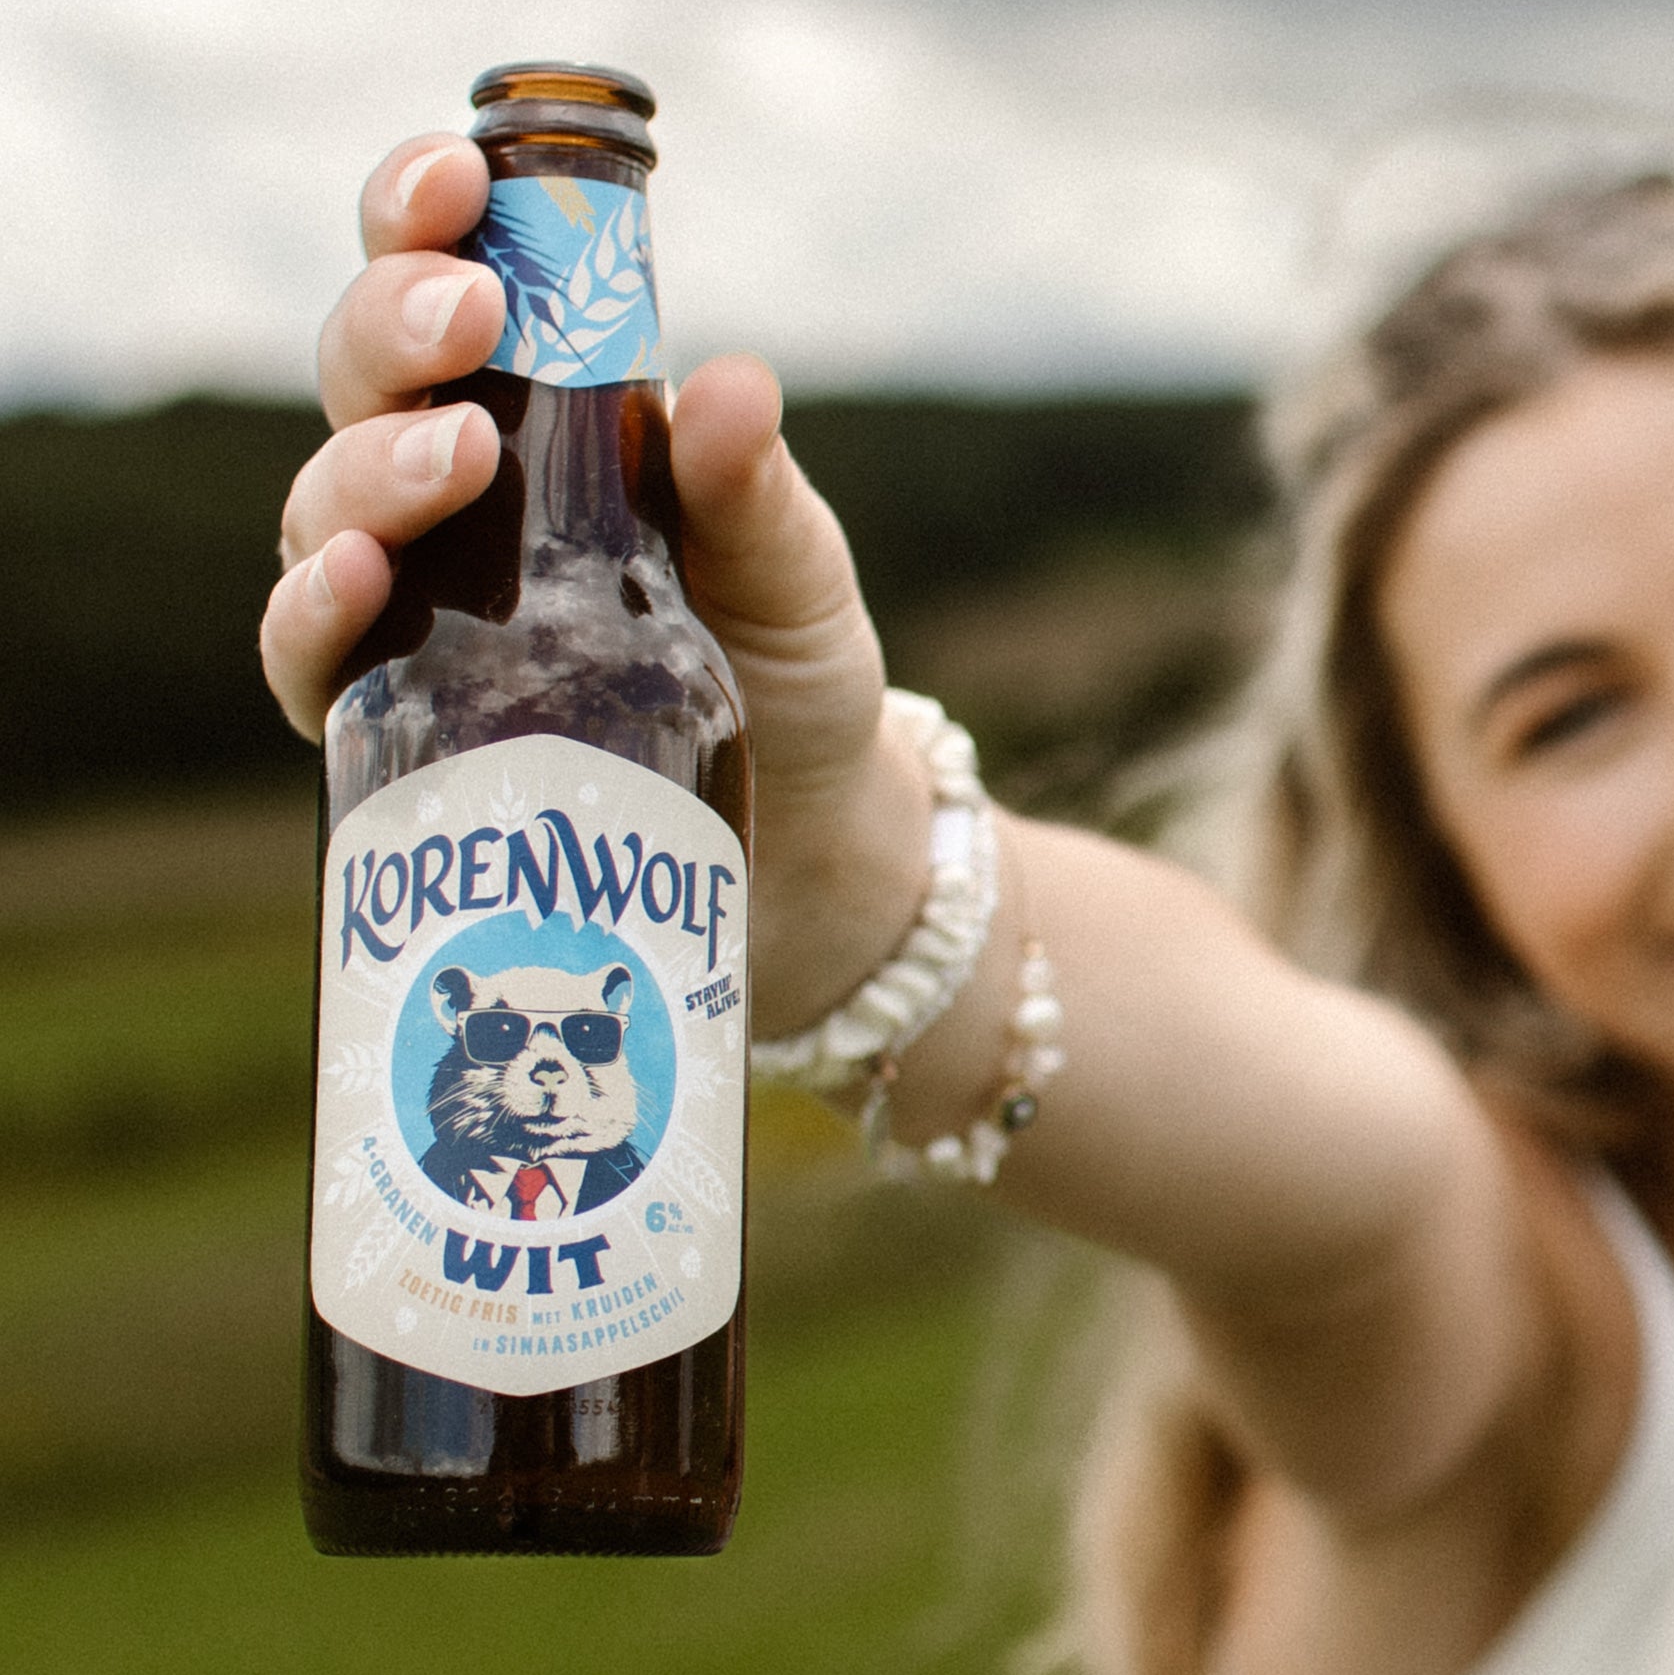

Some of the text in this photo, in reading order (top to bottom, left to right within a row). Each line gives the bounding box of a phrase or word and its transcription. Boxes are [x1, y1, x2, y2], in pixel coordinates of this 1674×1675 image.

[443, 1228, 611, 1294] WIT
[397, 1269, 658, 1325] ZOETIG FRIS MET KRUIDEN
[495, 1286, 686, 1356] SINAASAPPELSCHIL
